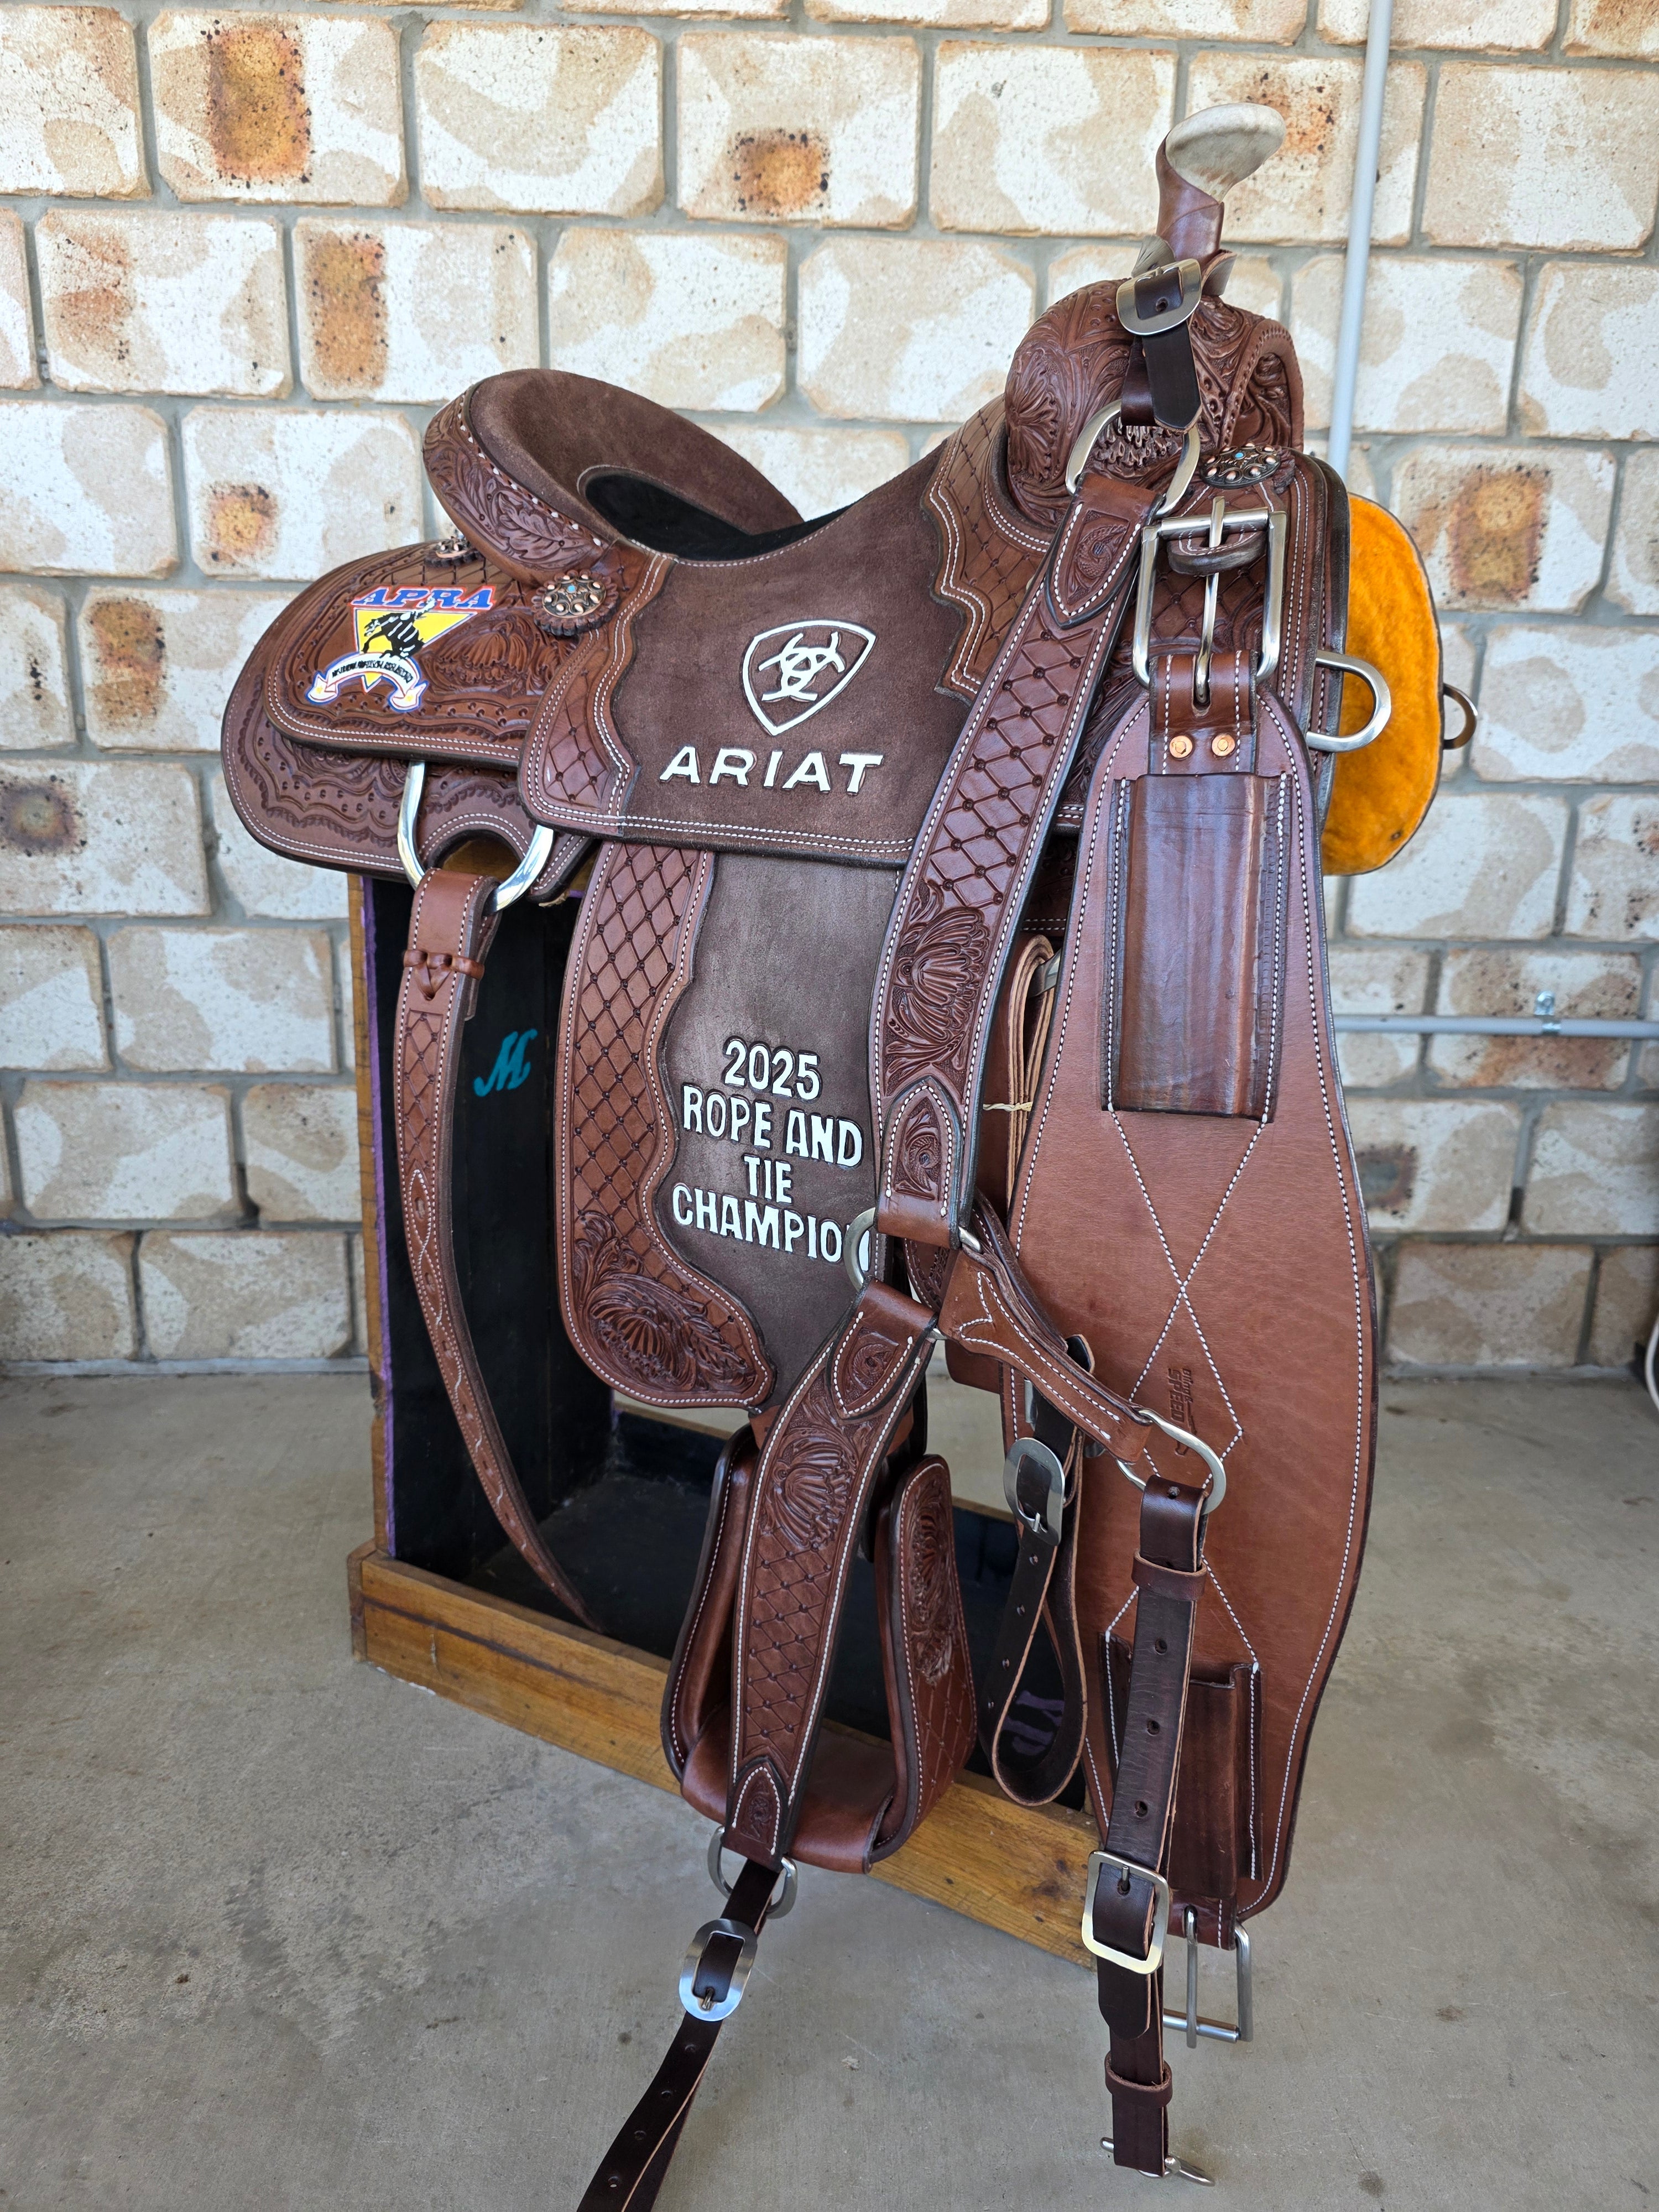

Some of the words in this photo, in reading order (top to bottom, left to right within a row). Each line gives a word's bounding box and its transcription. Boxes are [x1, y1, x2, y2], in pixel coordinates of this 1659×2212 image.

[349, 586, 495, 609] APRA
[659, 746, 883, 793] ARIAT
[724, 1040, 820, 1100] 2025
[683, 1085, 772, 1149] ROPE
[785, 1109, 862, 1167] AND
[743, 1155, 792, 1203] TIE
[1168, 1368, 1185, 1423] SPEED
